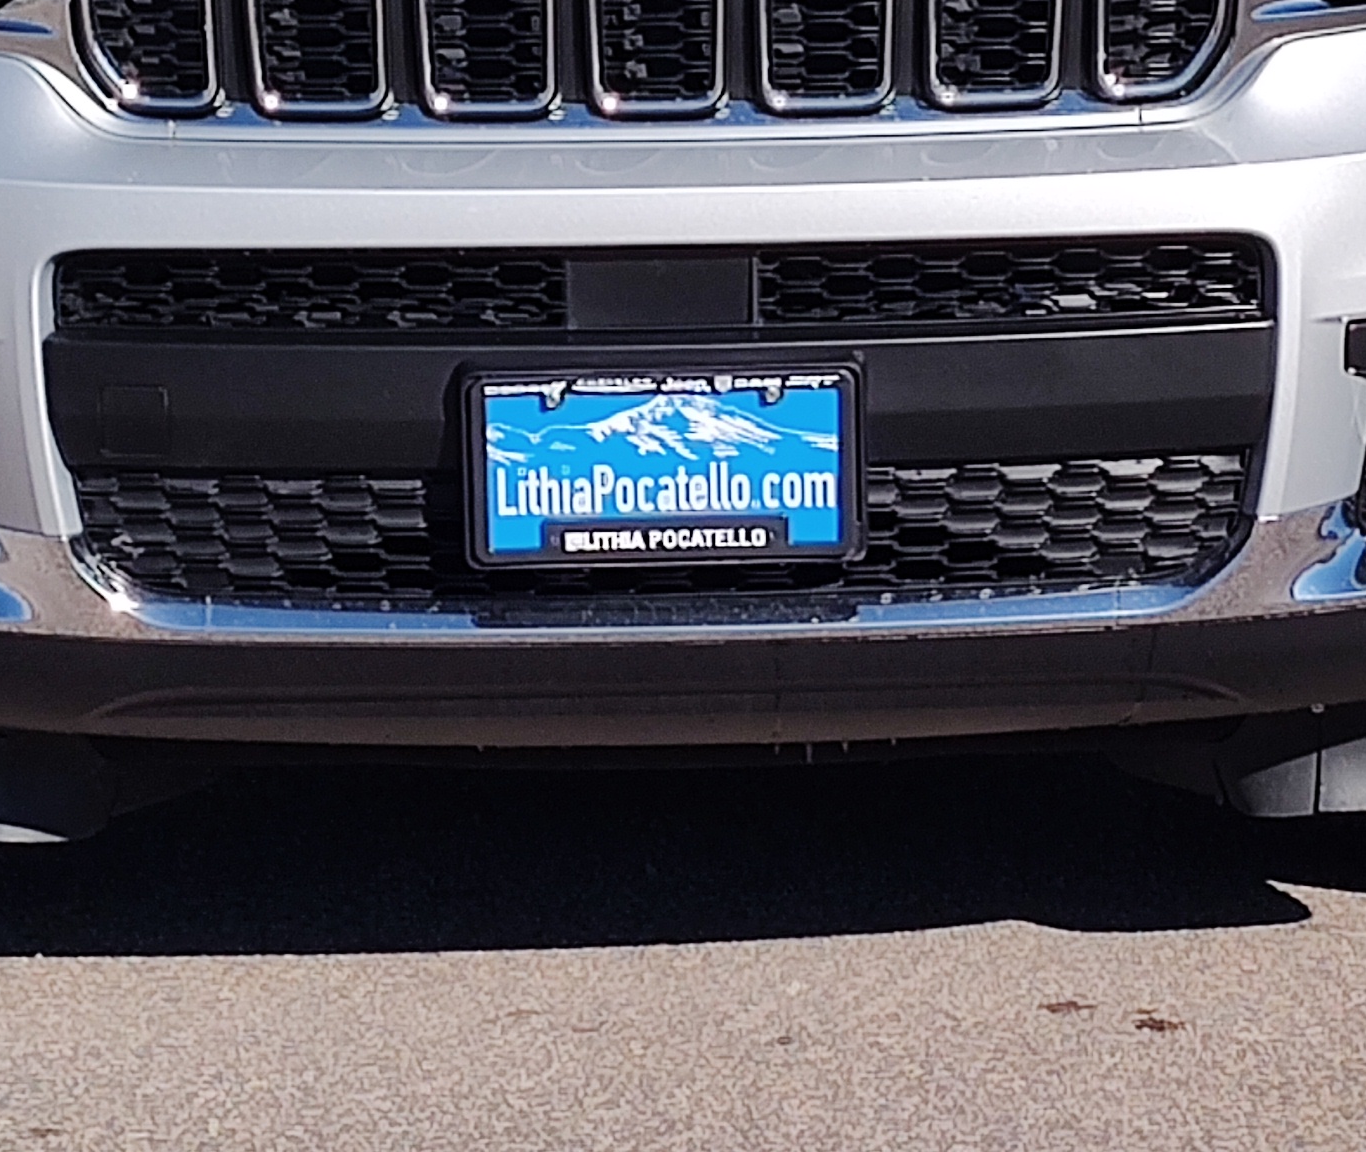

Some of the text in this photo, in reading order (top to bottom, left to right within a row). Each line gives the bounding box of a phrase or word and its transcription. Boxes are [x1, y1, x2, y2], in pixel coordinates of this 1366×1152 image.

[496, 461, 836, 516] LithiaPocatello.com
[585, 527, 767, 550] LITHIA POCATELLO
